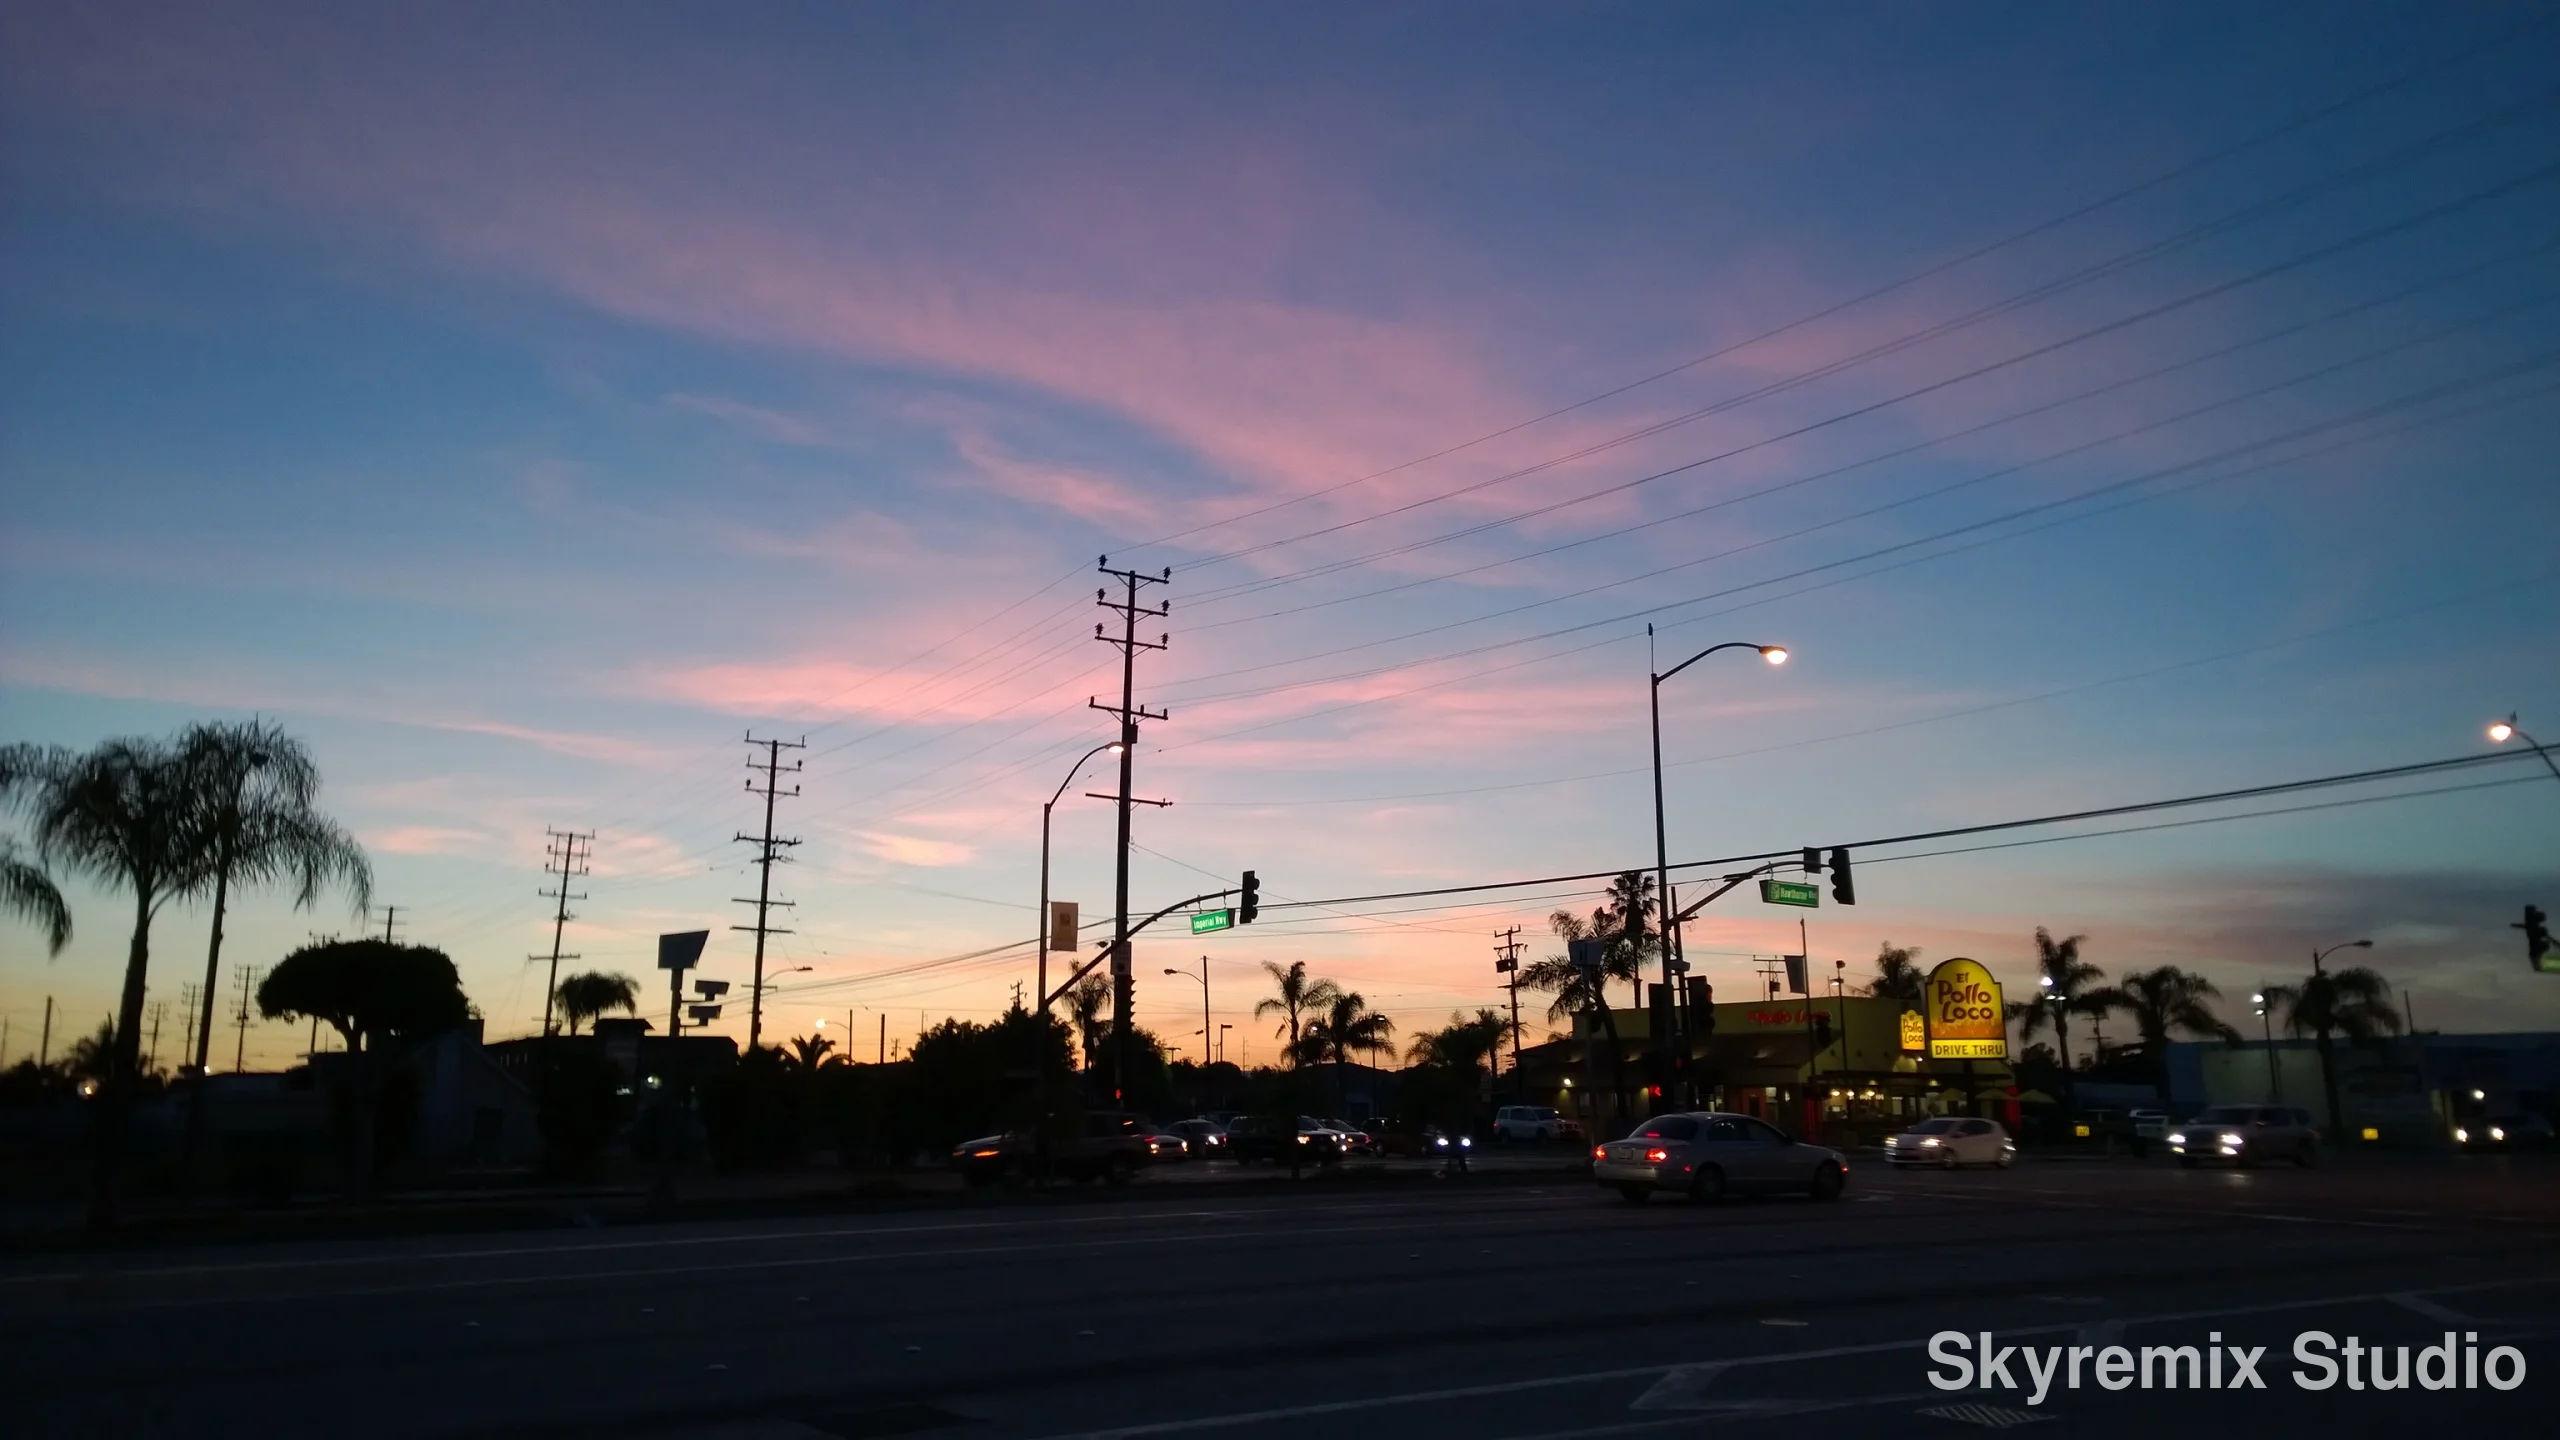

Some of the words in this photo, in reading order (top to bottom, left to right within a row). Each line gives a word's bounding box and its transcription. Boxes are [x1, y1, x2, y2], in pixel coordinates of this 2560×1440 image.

[1193, 917, 1214, 929] Imperial
[1215, 915, 1226, 925] Hwy
[1956, 972, 1969, 983] El
[1938, 980, 1992, 1004] Pollo
[1943, 1001, 1994, 1023] Loco
[1903, 1019, 1922, 1033] Pollo
[1905, 1031, 1923, 1044] Loco
[1935, 1044, 1969, 1055] DRIVE
[1973, 1044, 2003, 1055] THRU
